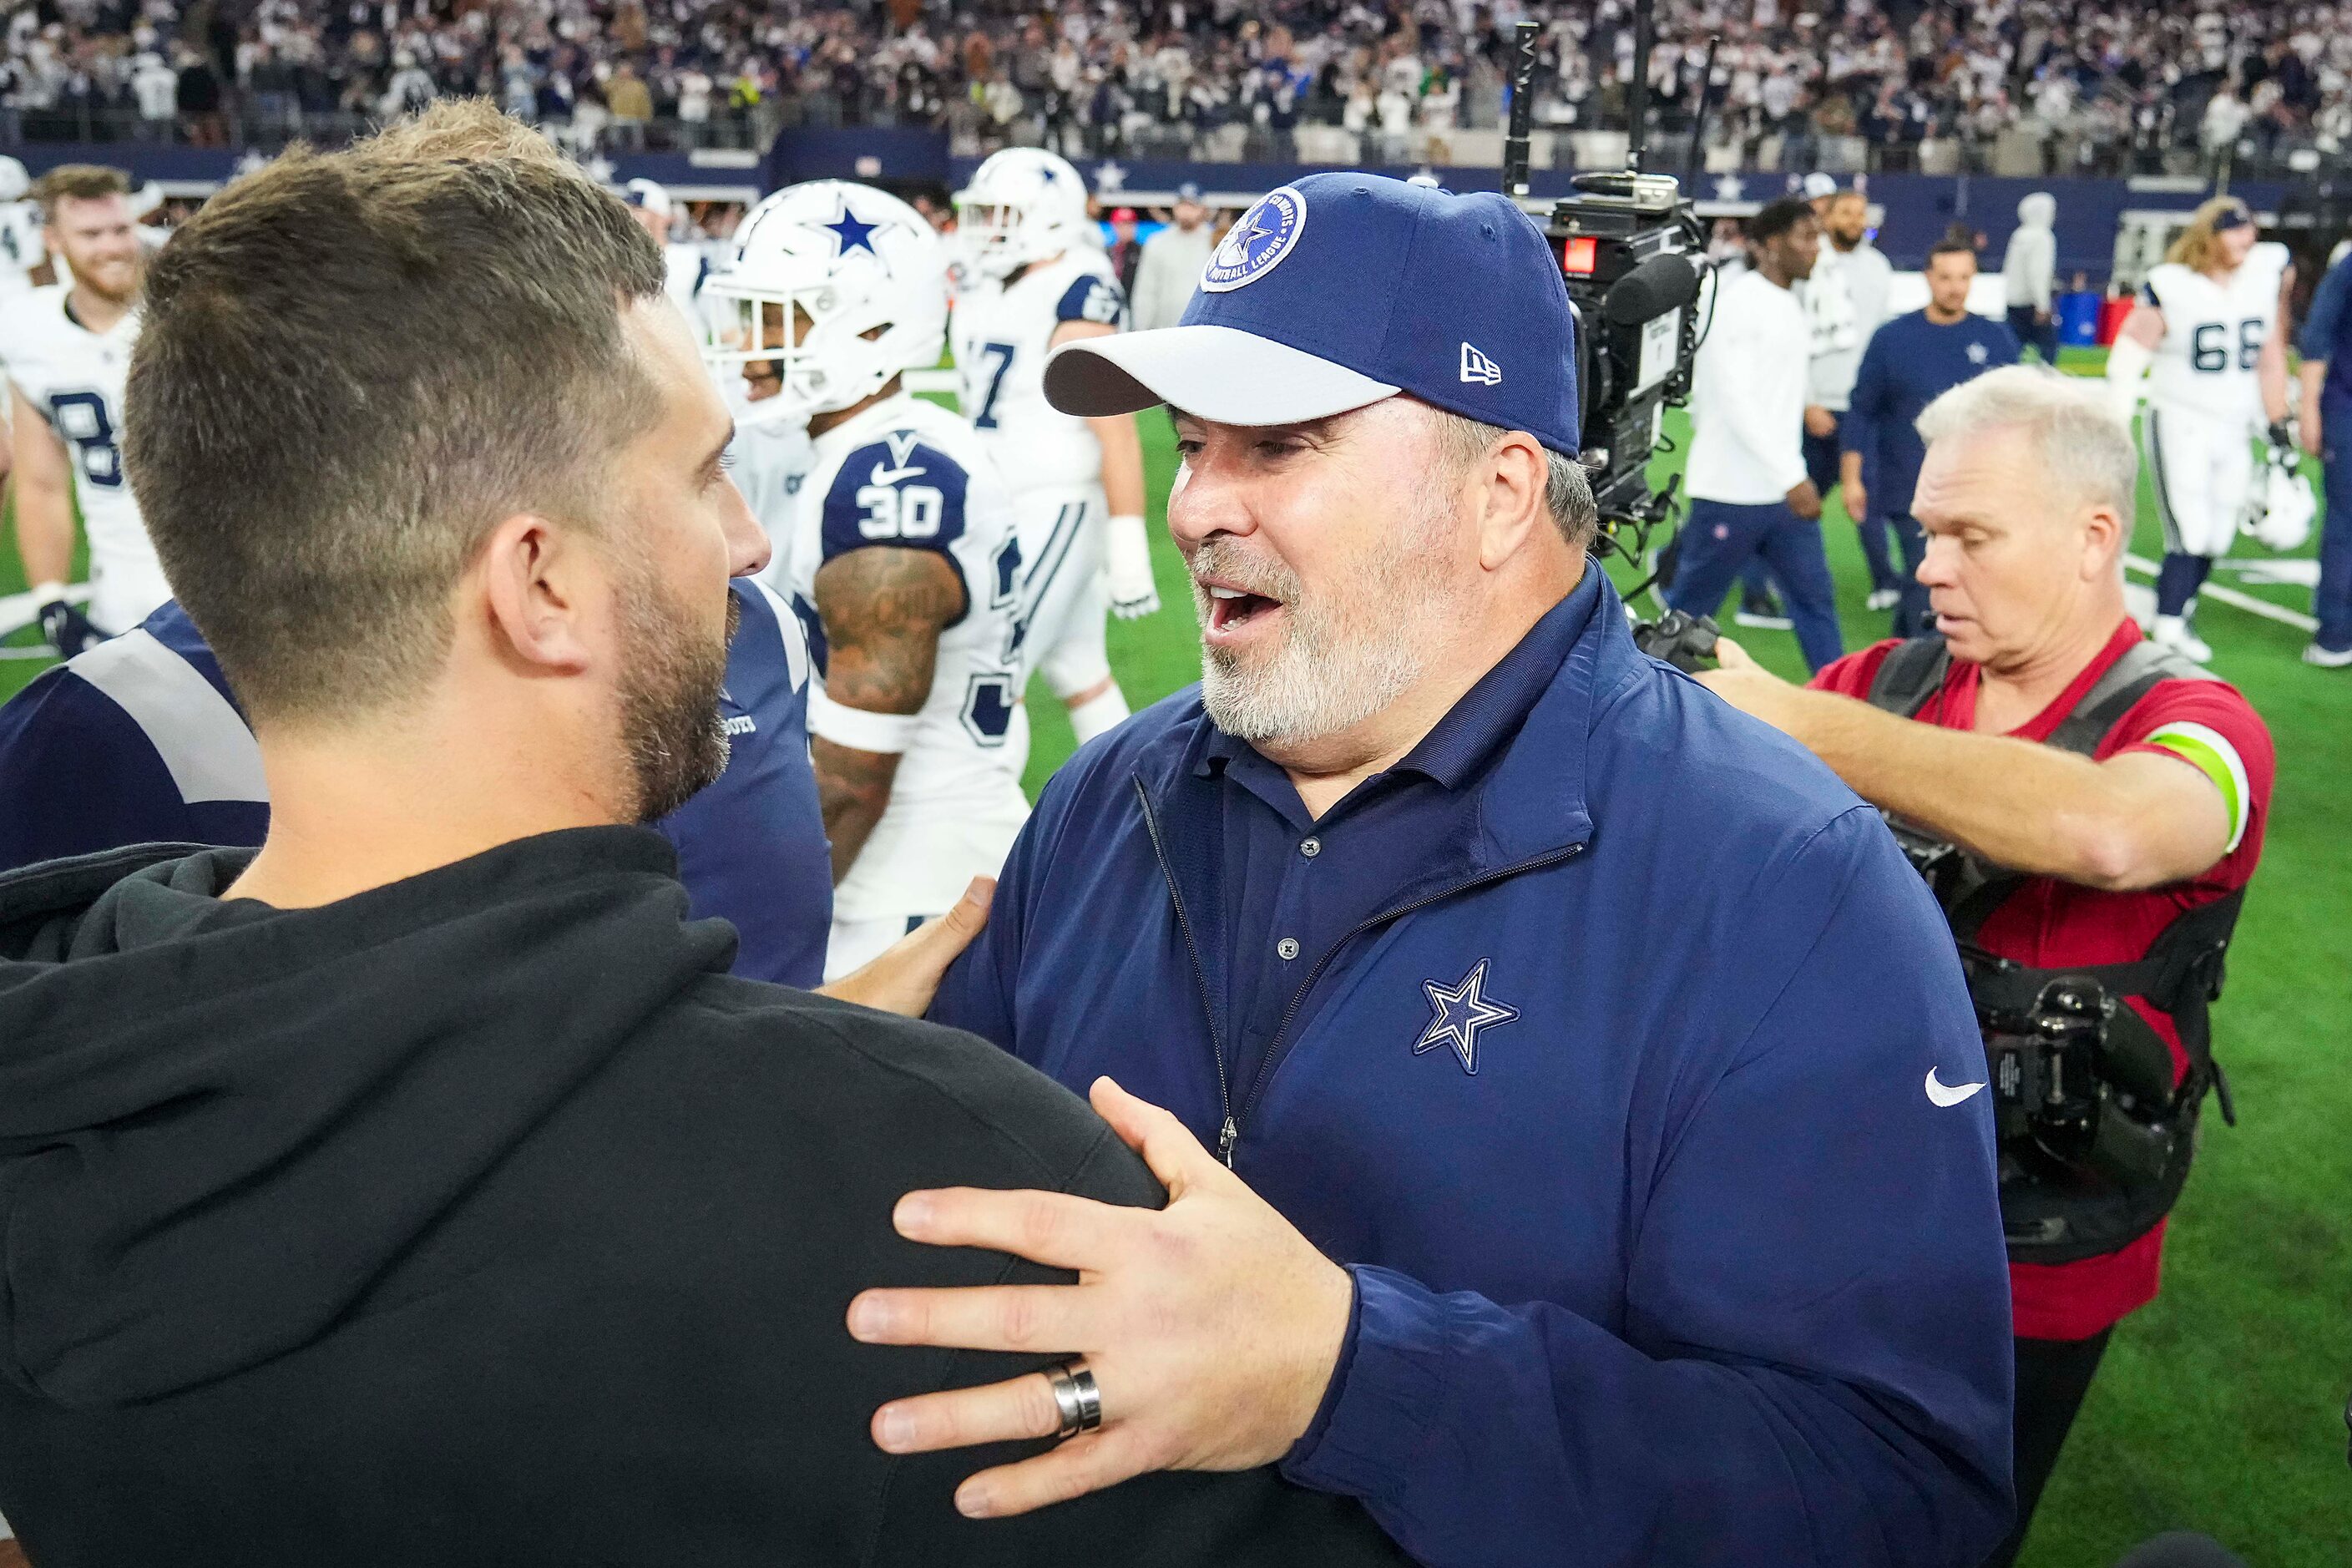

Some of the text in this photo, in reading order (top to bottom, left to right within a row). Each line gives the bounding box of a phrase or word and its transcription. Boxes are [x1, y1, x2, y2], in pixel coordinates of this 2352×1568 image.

[1268, 195, 1294, 227] COWBOYS
[1251, 235, 1287, 269] LEAGUE
[2192, 318, 2264, 372] 66
[855, 484, 943, 539] 30
